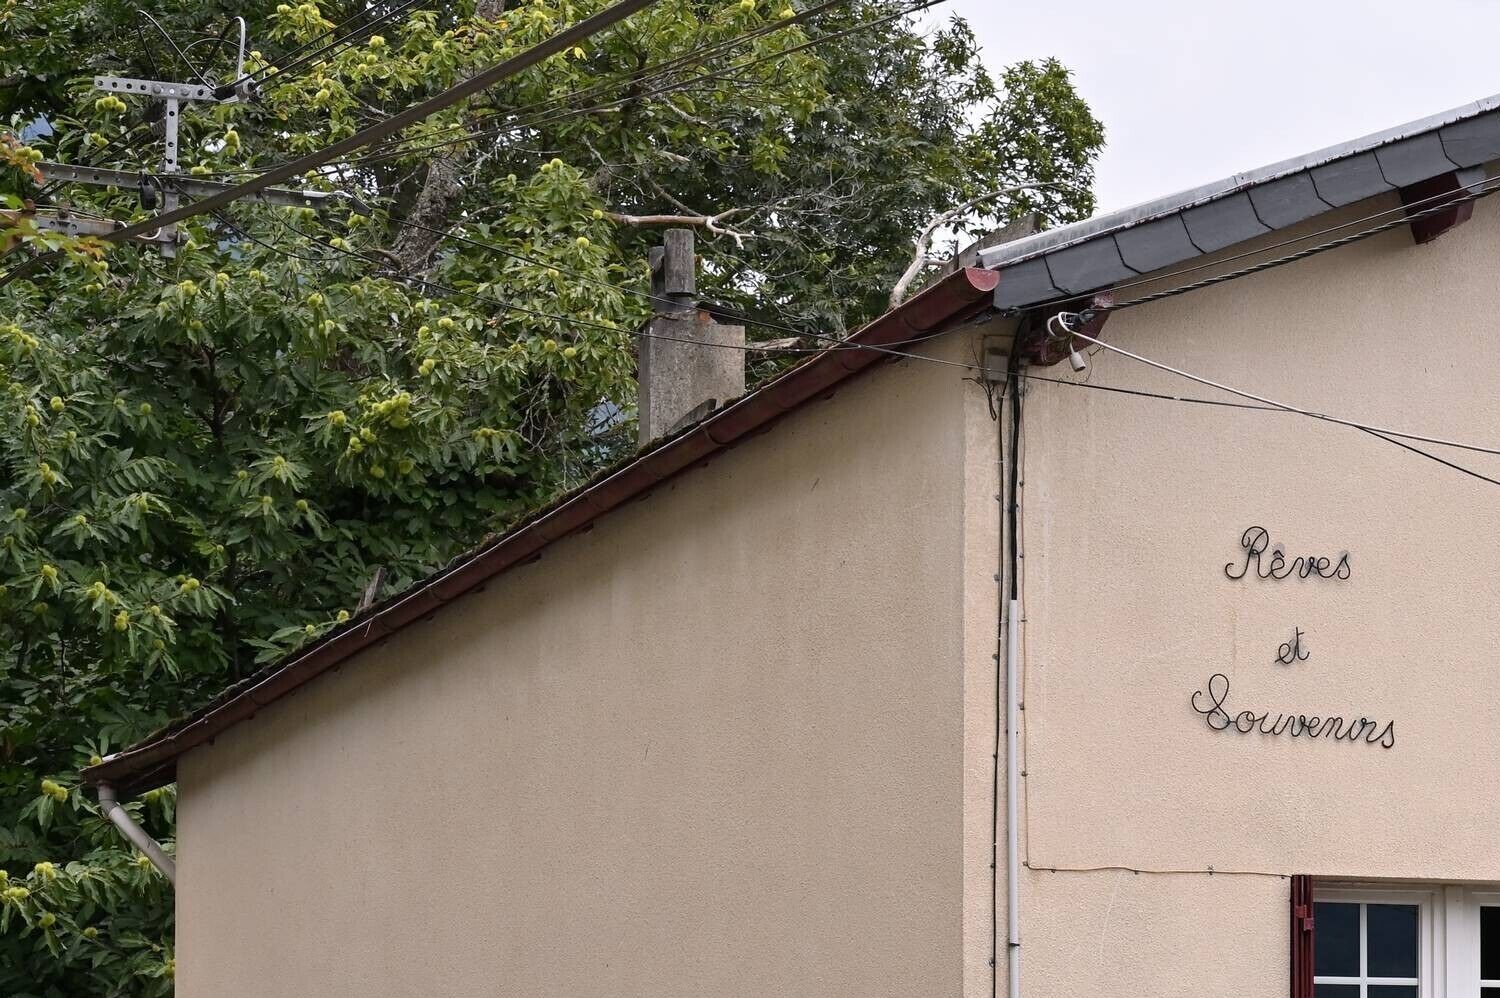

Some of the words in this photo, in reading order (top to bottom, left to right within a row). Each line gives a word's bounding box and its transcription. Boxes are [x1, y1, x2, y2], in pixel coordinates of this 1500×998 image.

[1225, 526, 1351, 579] Rêves
[1275, 627, 1310, 664] et
[1191, 673, 1395, 748] Souvenirs
